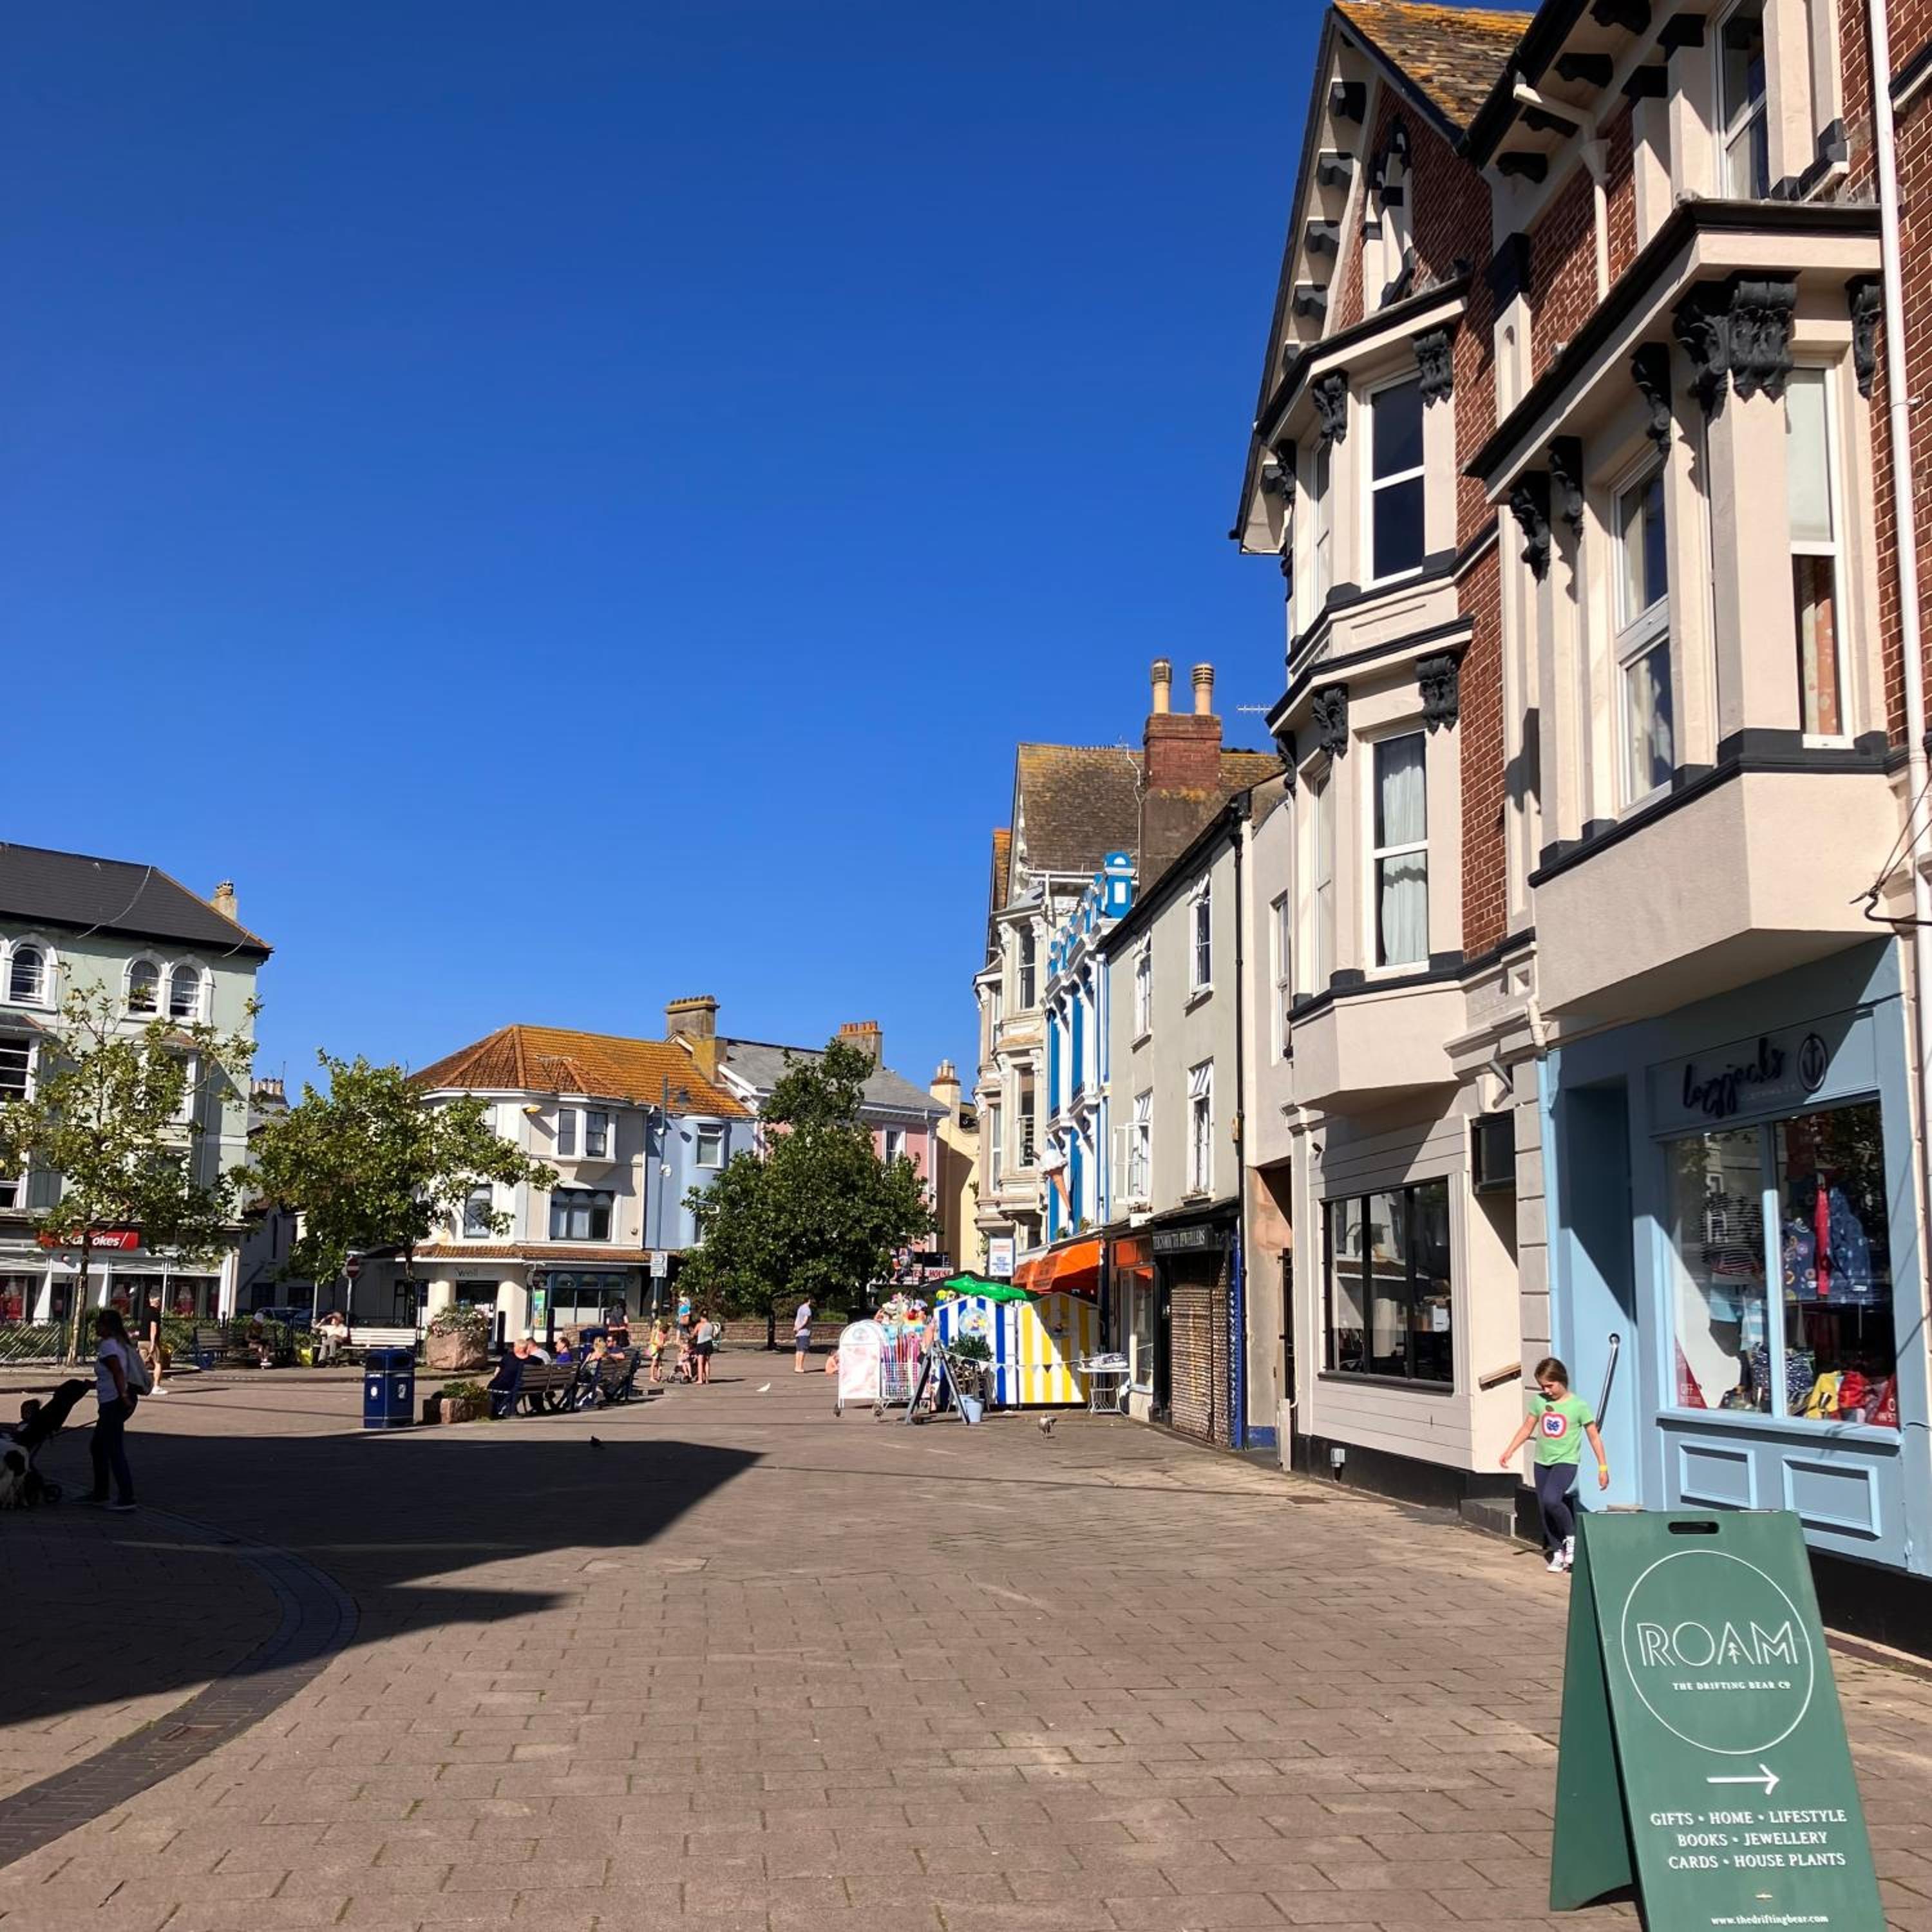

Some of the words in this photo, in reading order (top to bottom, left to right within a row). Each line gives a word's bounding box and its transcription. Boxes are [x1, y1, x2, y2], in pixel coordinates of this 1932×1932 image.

[1636, 1621, 1799, 1667] ROAM
[1672, 1682, 1693, 1690] THE
[1696, 1681, 1746, 1690] DRIFTING
[1748, 1681, 1775, 1689] BEAR
[1650, 1813, 1694, 1826] GIFTS
[1709, 1811, 1754, 1824] HOME
[1768, 1809, 1847, 1824] LIFESTYLE
[1677, 1833, 1728, 1847] BOOKS
[1743, 1832, 1828, 1846] JEWELLERY
[1668, 1855, 1719, 1869] CARDS
[1734, 1854, 1786, 1868] HOUSE
[1789, 1852, 1846, 1866] PLANTS
[1710, 1915, 1829, 1926] www.thedriftingbear.com
